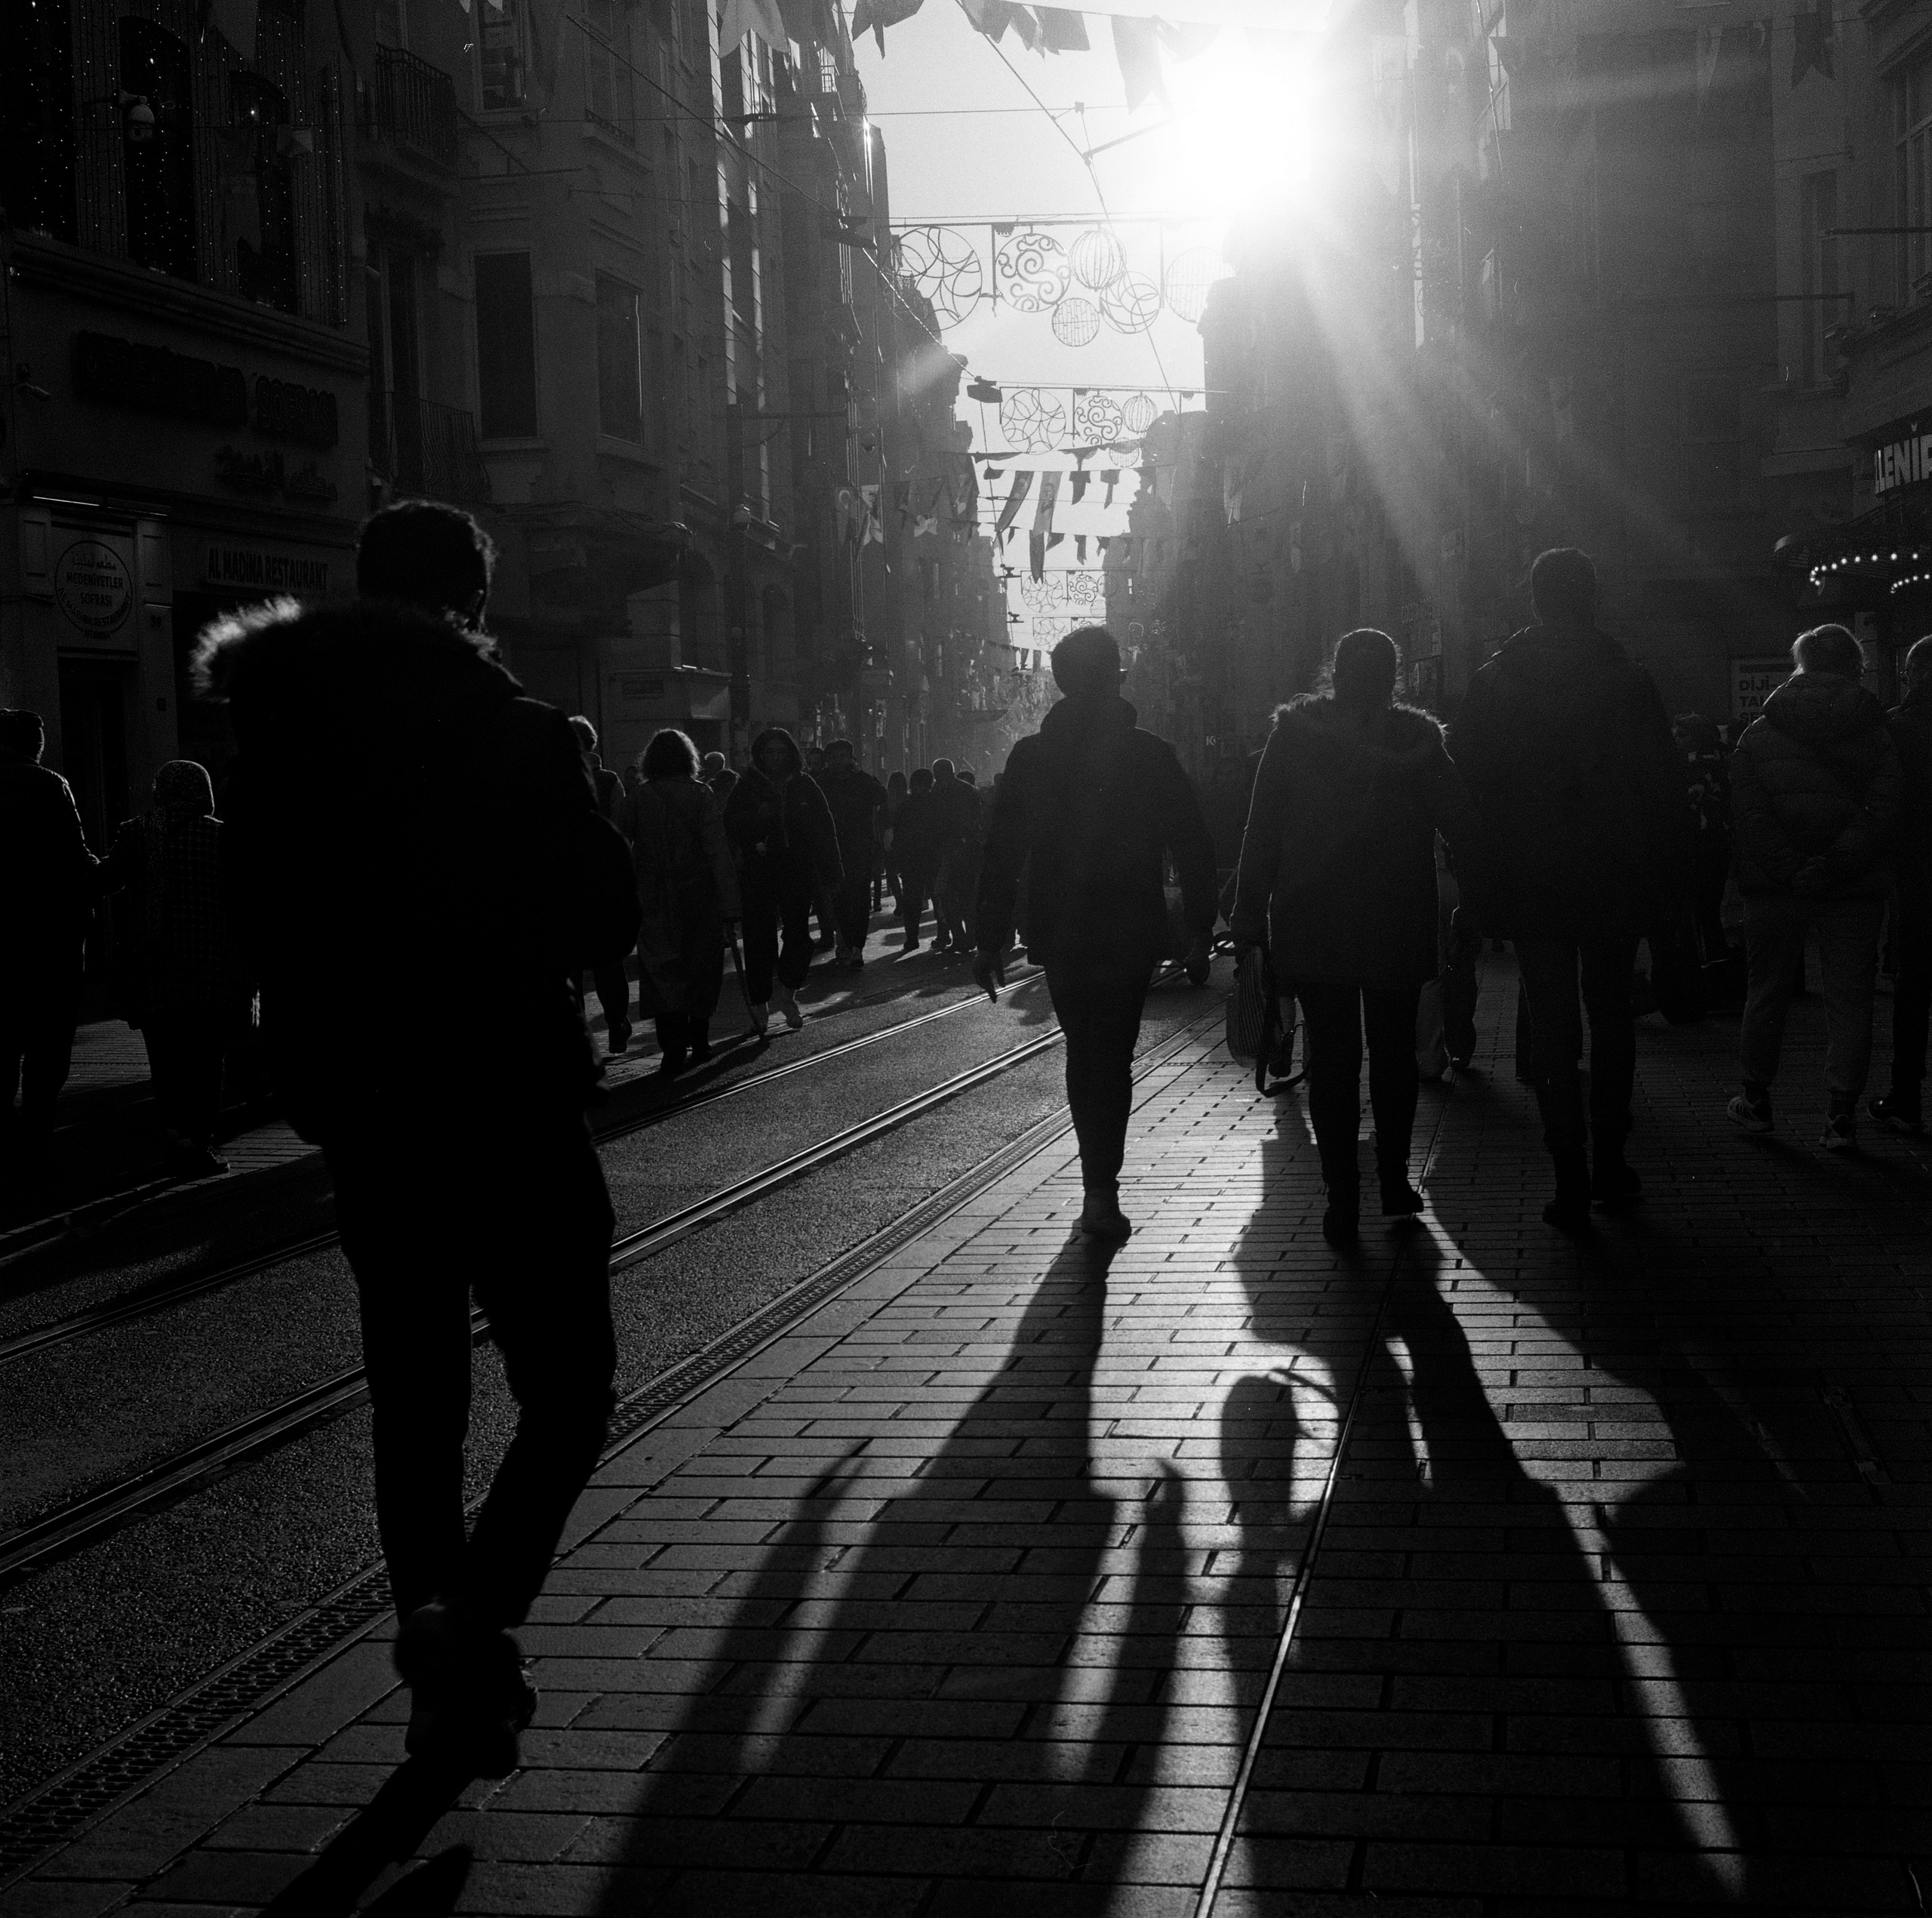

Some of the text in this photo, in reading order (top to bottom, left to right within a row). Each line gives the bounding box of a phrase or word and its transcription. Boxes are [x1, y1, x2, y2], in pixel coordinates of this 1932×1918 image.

[208, 547, 328, 590] AL MADİNA RESTAURANT
[66, 571, 124, 589] MEDENİYETLER
[80, 593, 112, 606] SOFRASI
